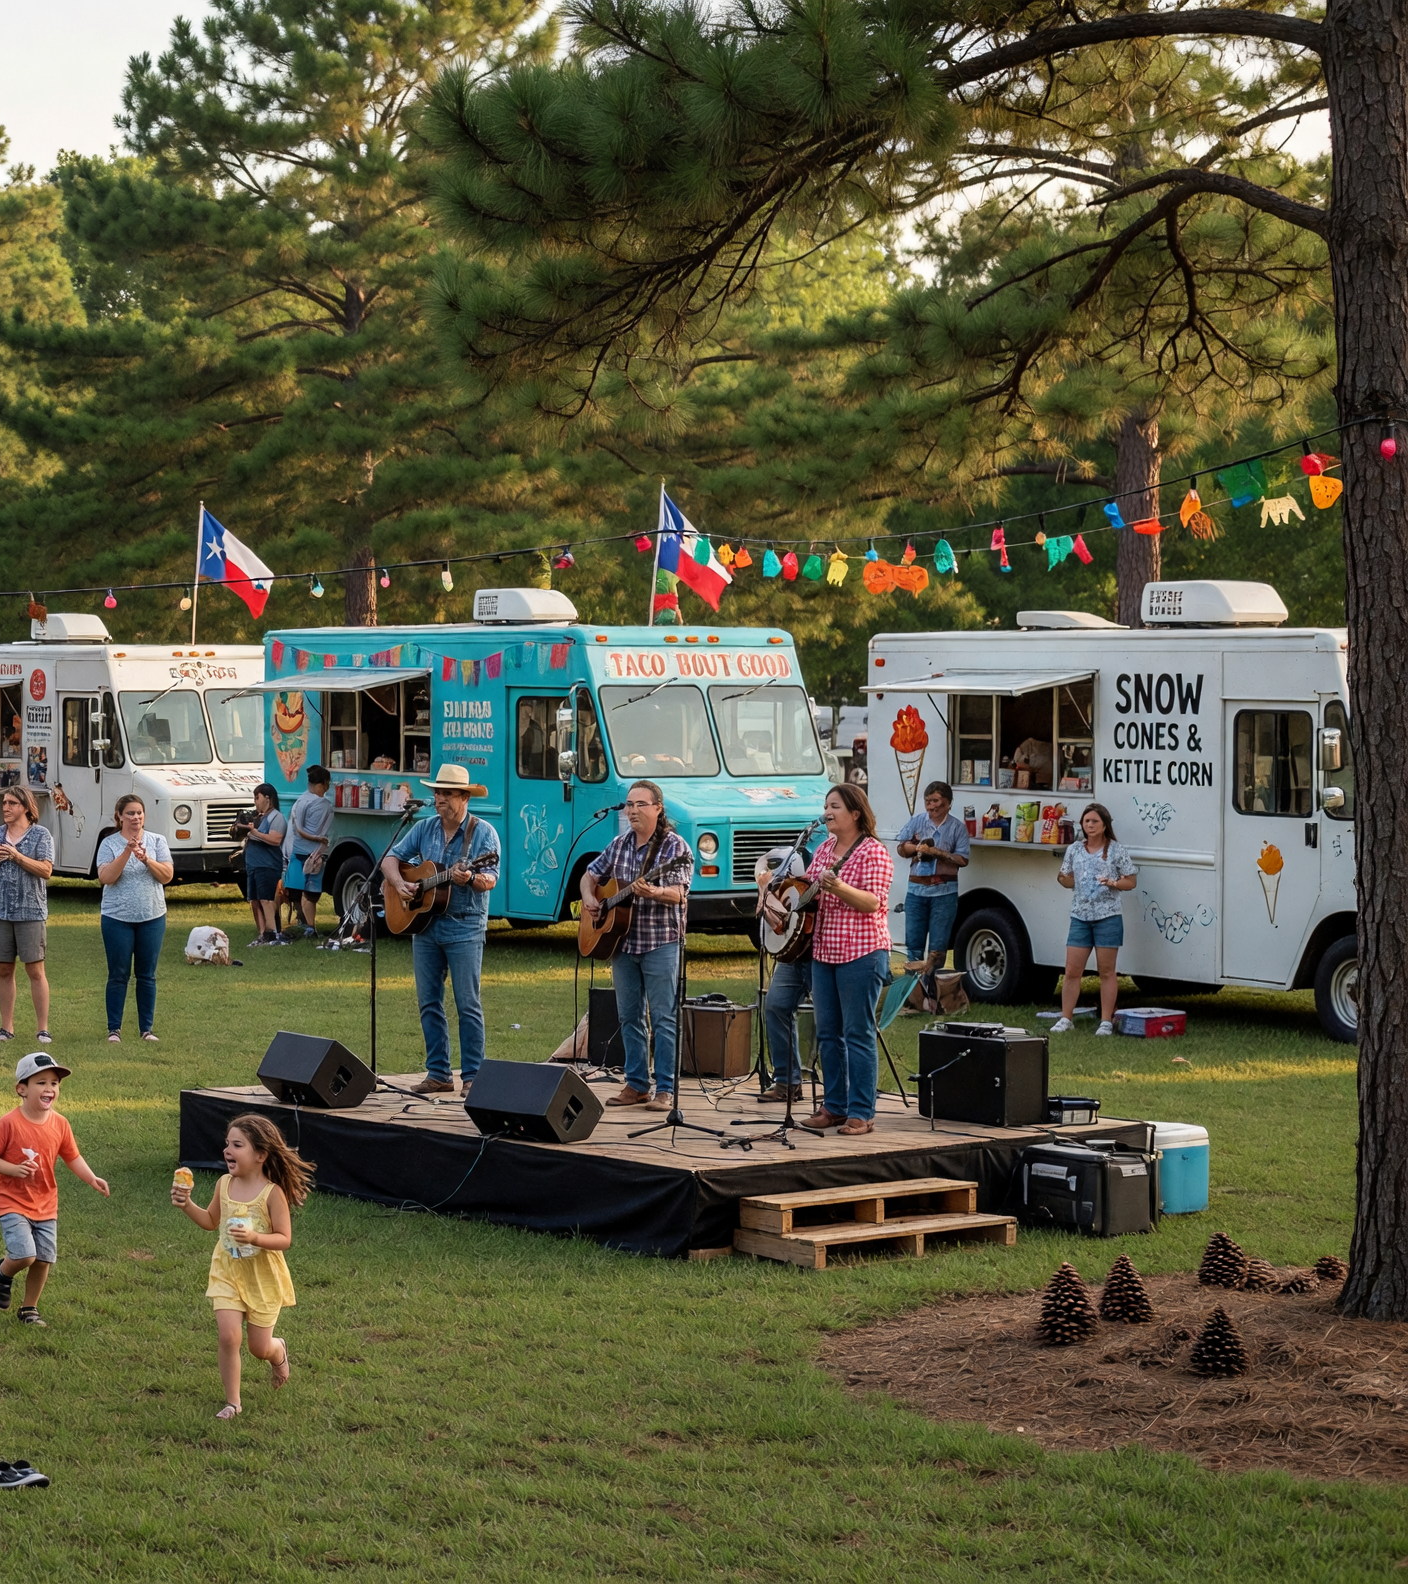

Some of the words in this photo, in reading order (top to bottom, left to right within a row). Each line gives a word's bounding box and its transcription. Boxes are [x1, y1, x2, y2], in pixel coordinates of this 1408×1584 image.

[610, 652, 666, 677] TACO
[1115, 673, 1204, 715] SNOW
[1114, 722, 1179, 751] CONES
[1187, 724, 1202, 753] &
[1103, 758, 1162, 785] KETTLE
[1167, 761, 1213, 787] CORN
